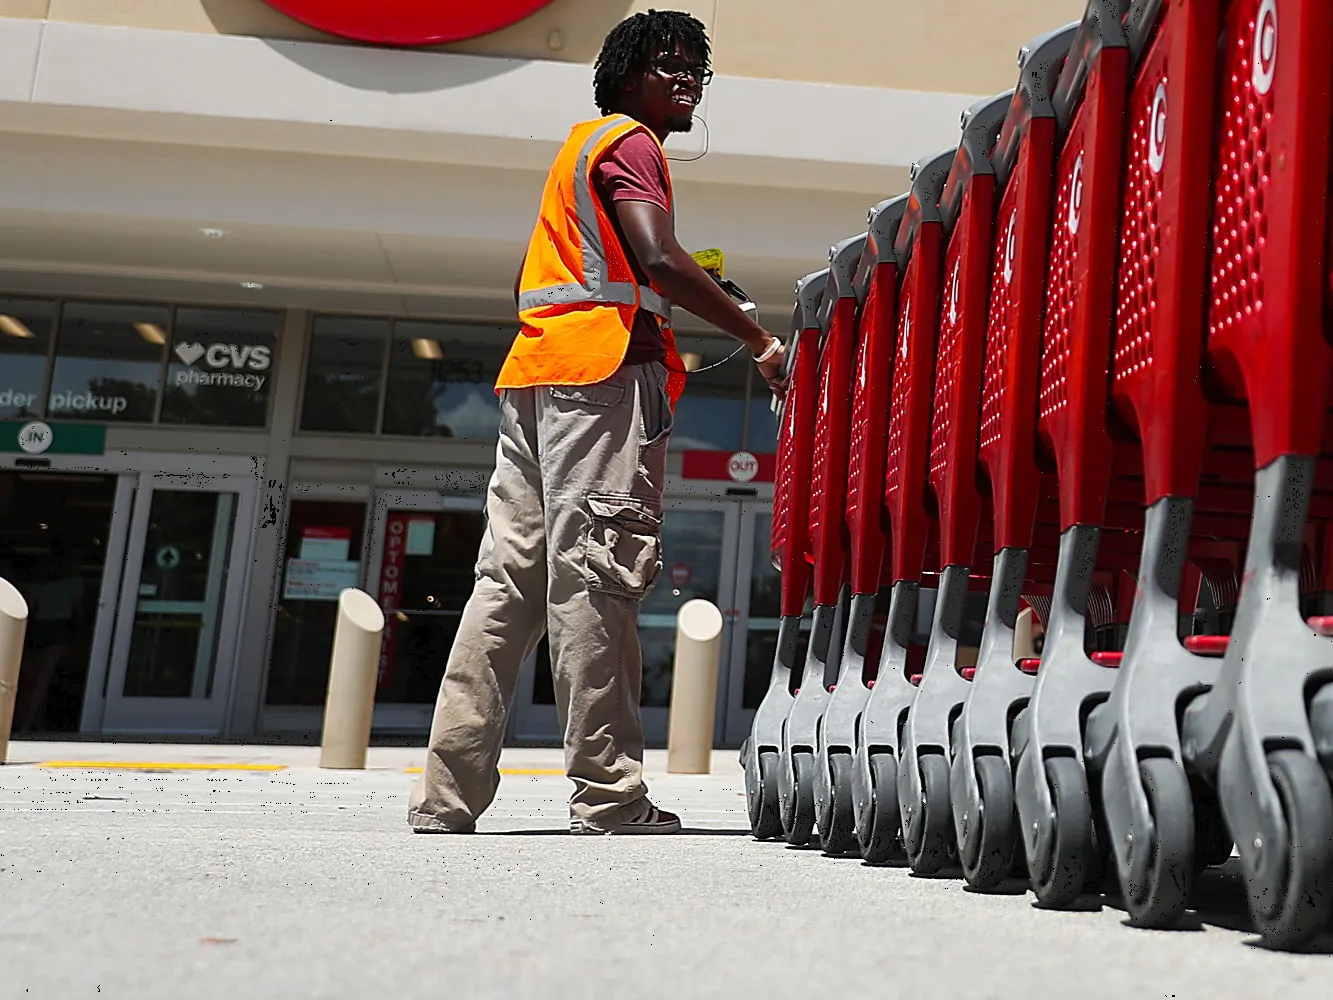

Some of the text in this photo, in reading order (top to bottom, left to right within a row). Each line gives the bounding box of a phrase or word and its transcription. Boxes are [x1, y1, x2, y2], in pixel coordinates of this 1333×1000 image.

[206, 343, 271, 371] CVS
[175, 370, 265, 391] pharmacy
[48, 388, 127, 415] pickup
[29, 432, 44, 444] IN
[730, 460, 756, 472] OUT
